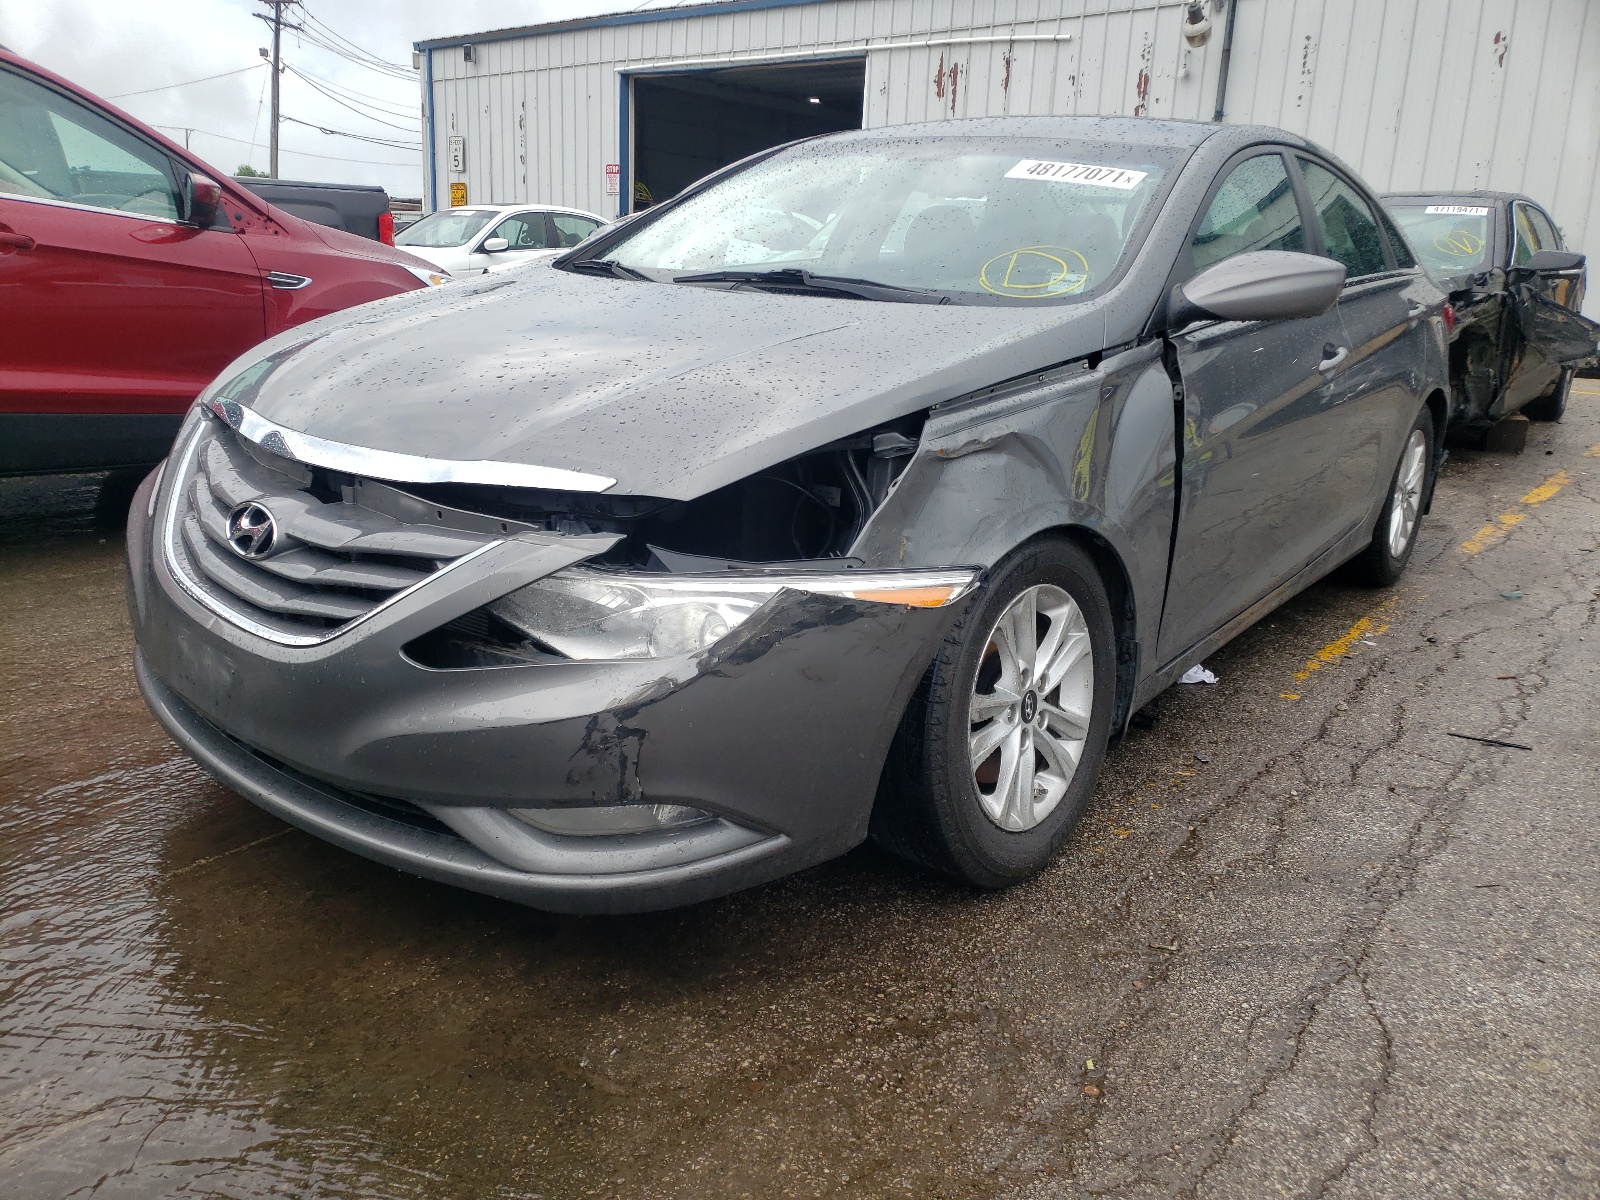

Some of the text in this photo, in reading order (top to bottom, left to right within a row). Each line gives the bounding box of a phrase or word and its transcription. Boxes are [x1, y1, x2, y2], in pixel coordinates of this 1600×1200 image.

[453, 155, 460, 168] 5
[606, 165, 619, 173] STOP
[1026, 162, 1126, 183] 48177071
[1001, 250, 1067, 288] D
